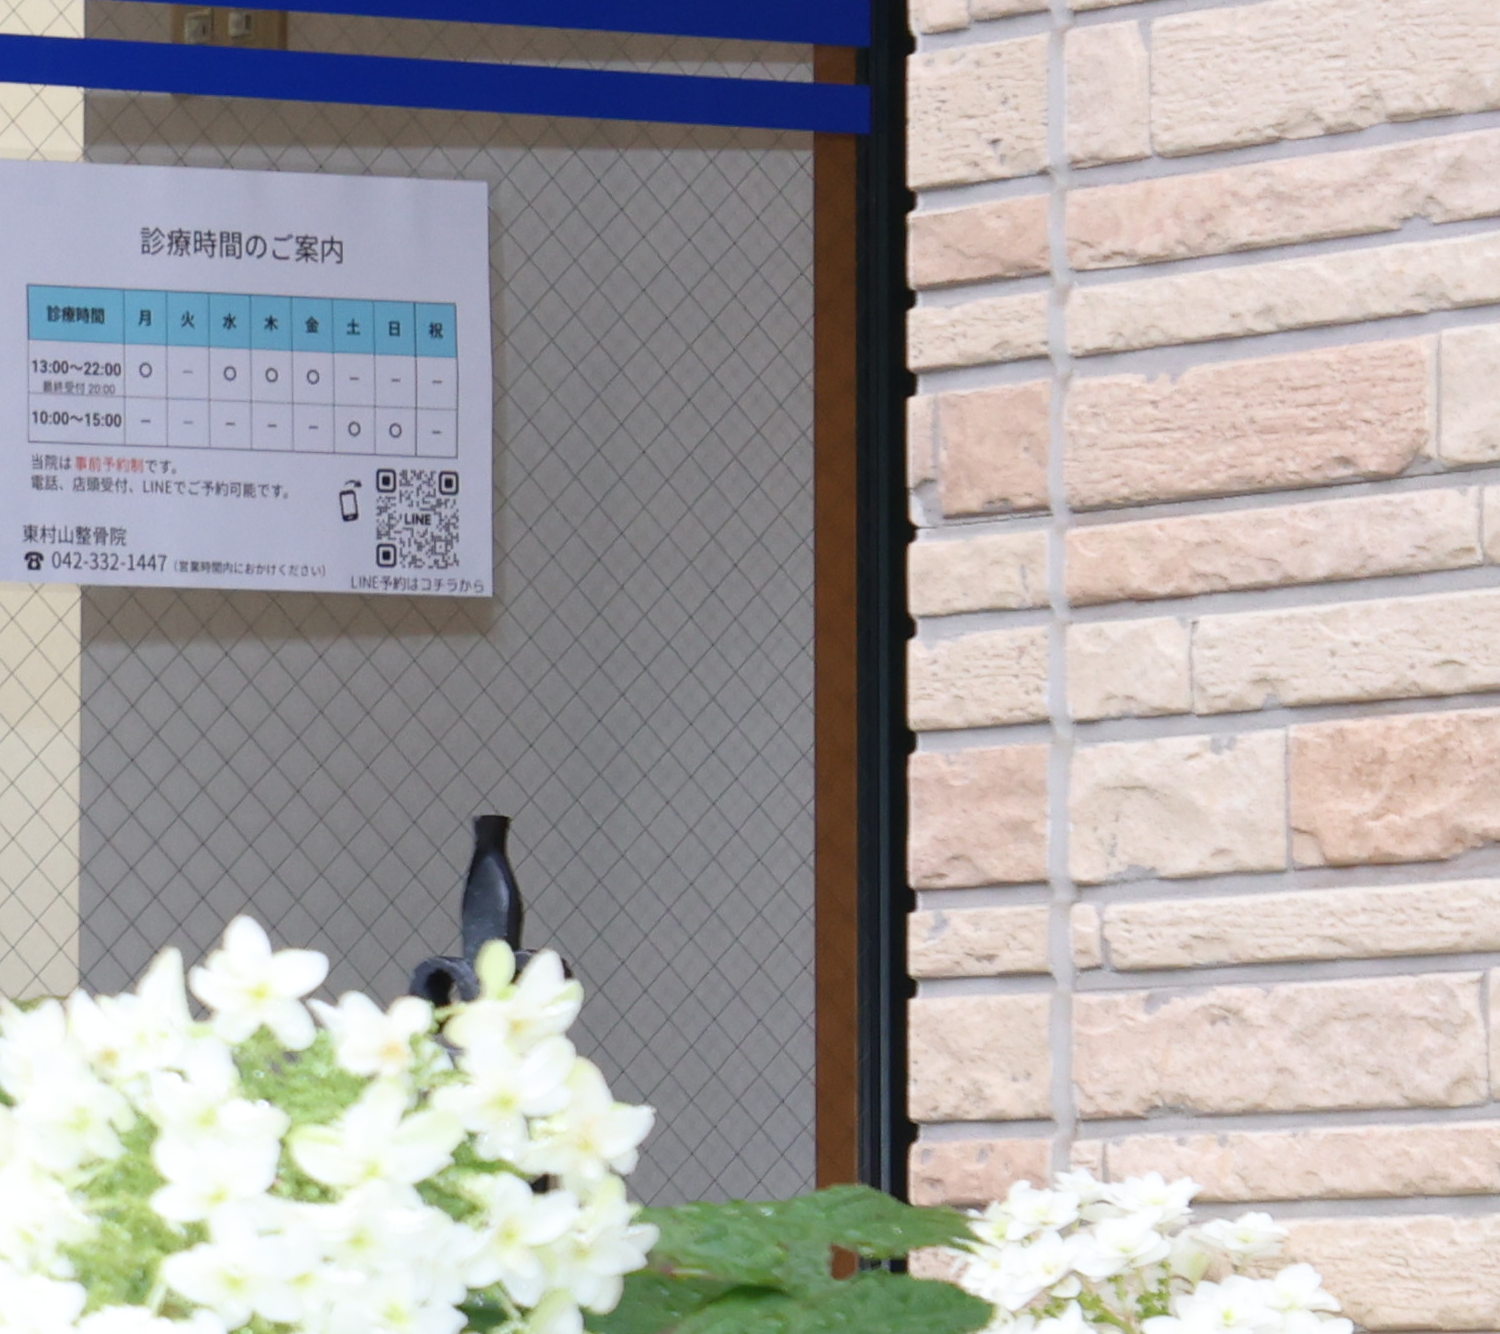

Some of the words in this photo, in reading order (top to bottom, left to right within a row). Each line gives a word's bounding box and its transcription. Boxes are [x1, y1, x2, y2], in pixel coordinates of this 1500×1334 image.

[140, 227, 343, 264] 診療時間のご案内
[46, 305, 105, 324] 診療時間
[137, 309, 152, 327] 月
[181, 311, 196, 329] 火
[222, 313, 237, 330] 水
[264, 315, 279, 331] 木
[305, 316, 319, 333] 金
[346, 318, 361, 335] 土
[388, 321, 401, 337] 日
[428, 322, 444, 339] 祝
[404, 513, 431, 526] LINE
[22, 524, 127, 546] 東村山整骨院
[51, 551, 168, 572] 042-332-1447
[350, 575, 484, 593] LINE予約はコチラから
